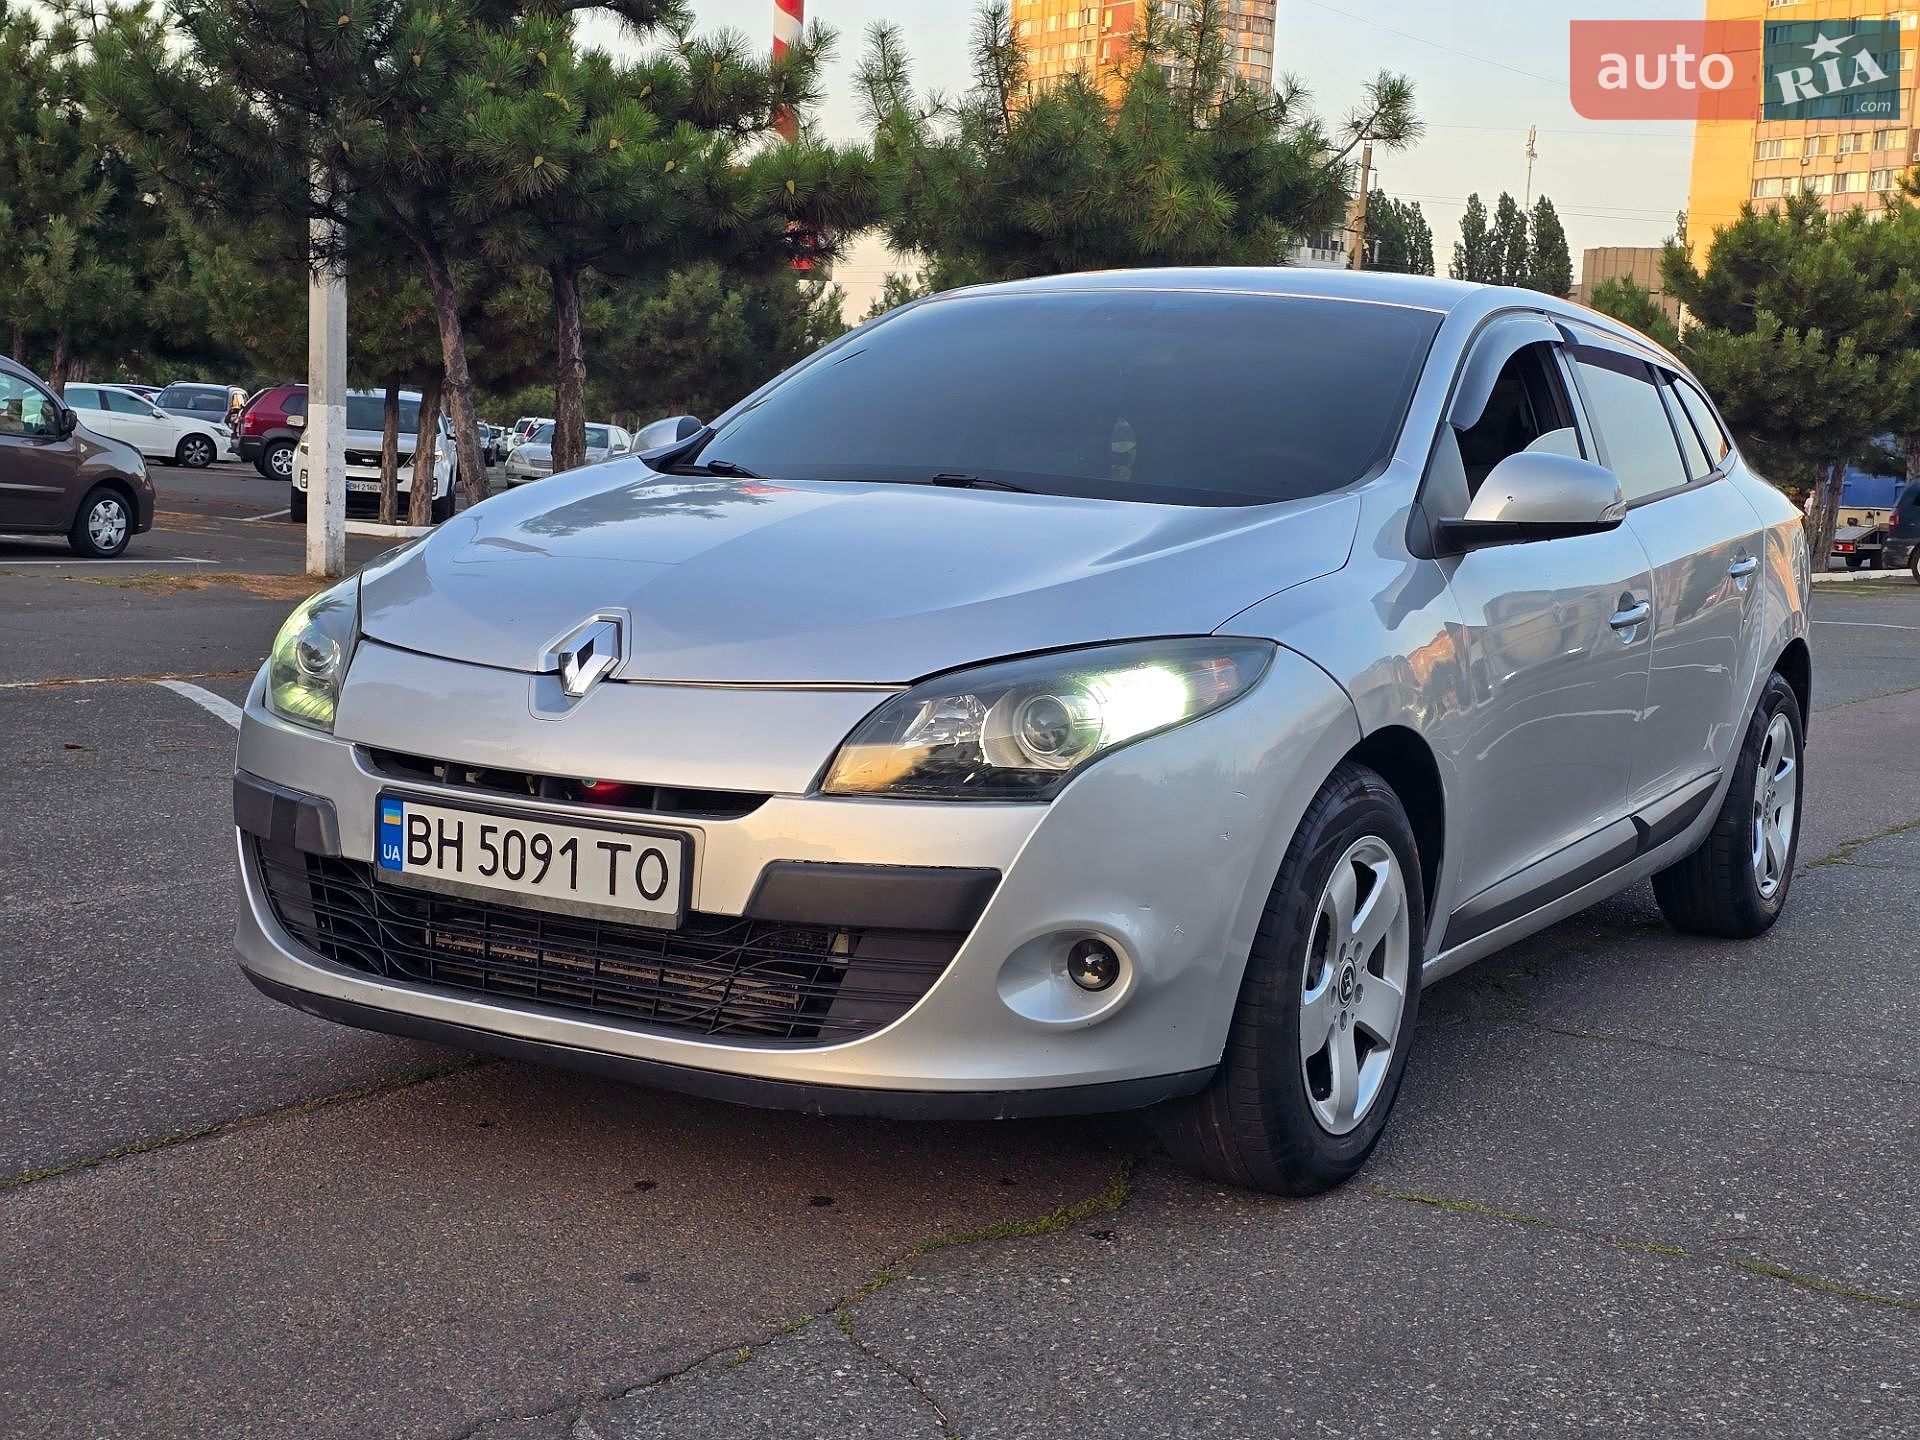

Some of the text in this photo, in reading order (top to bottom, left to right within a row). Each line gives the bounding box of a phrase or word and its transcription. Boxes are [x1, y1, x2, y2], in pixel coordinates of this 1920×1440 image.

[383, 844, 401, 862] UA
[407, 813, 669, 901] BH 5091 TO
